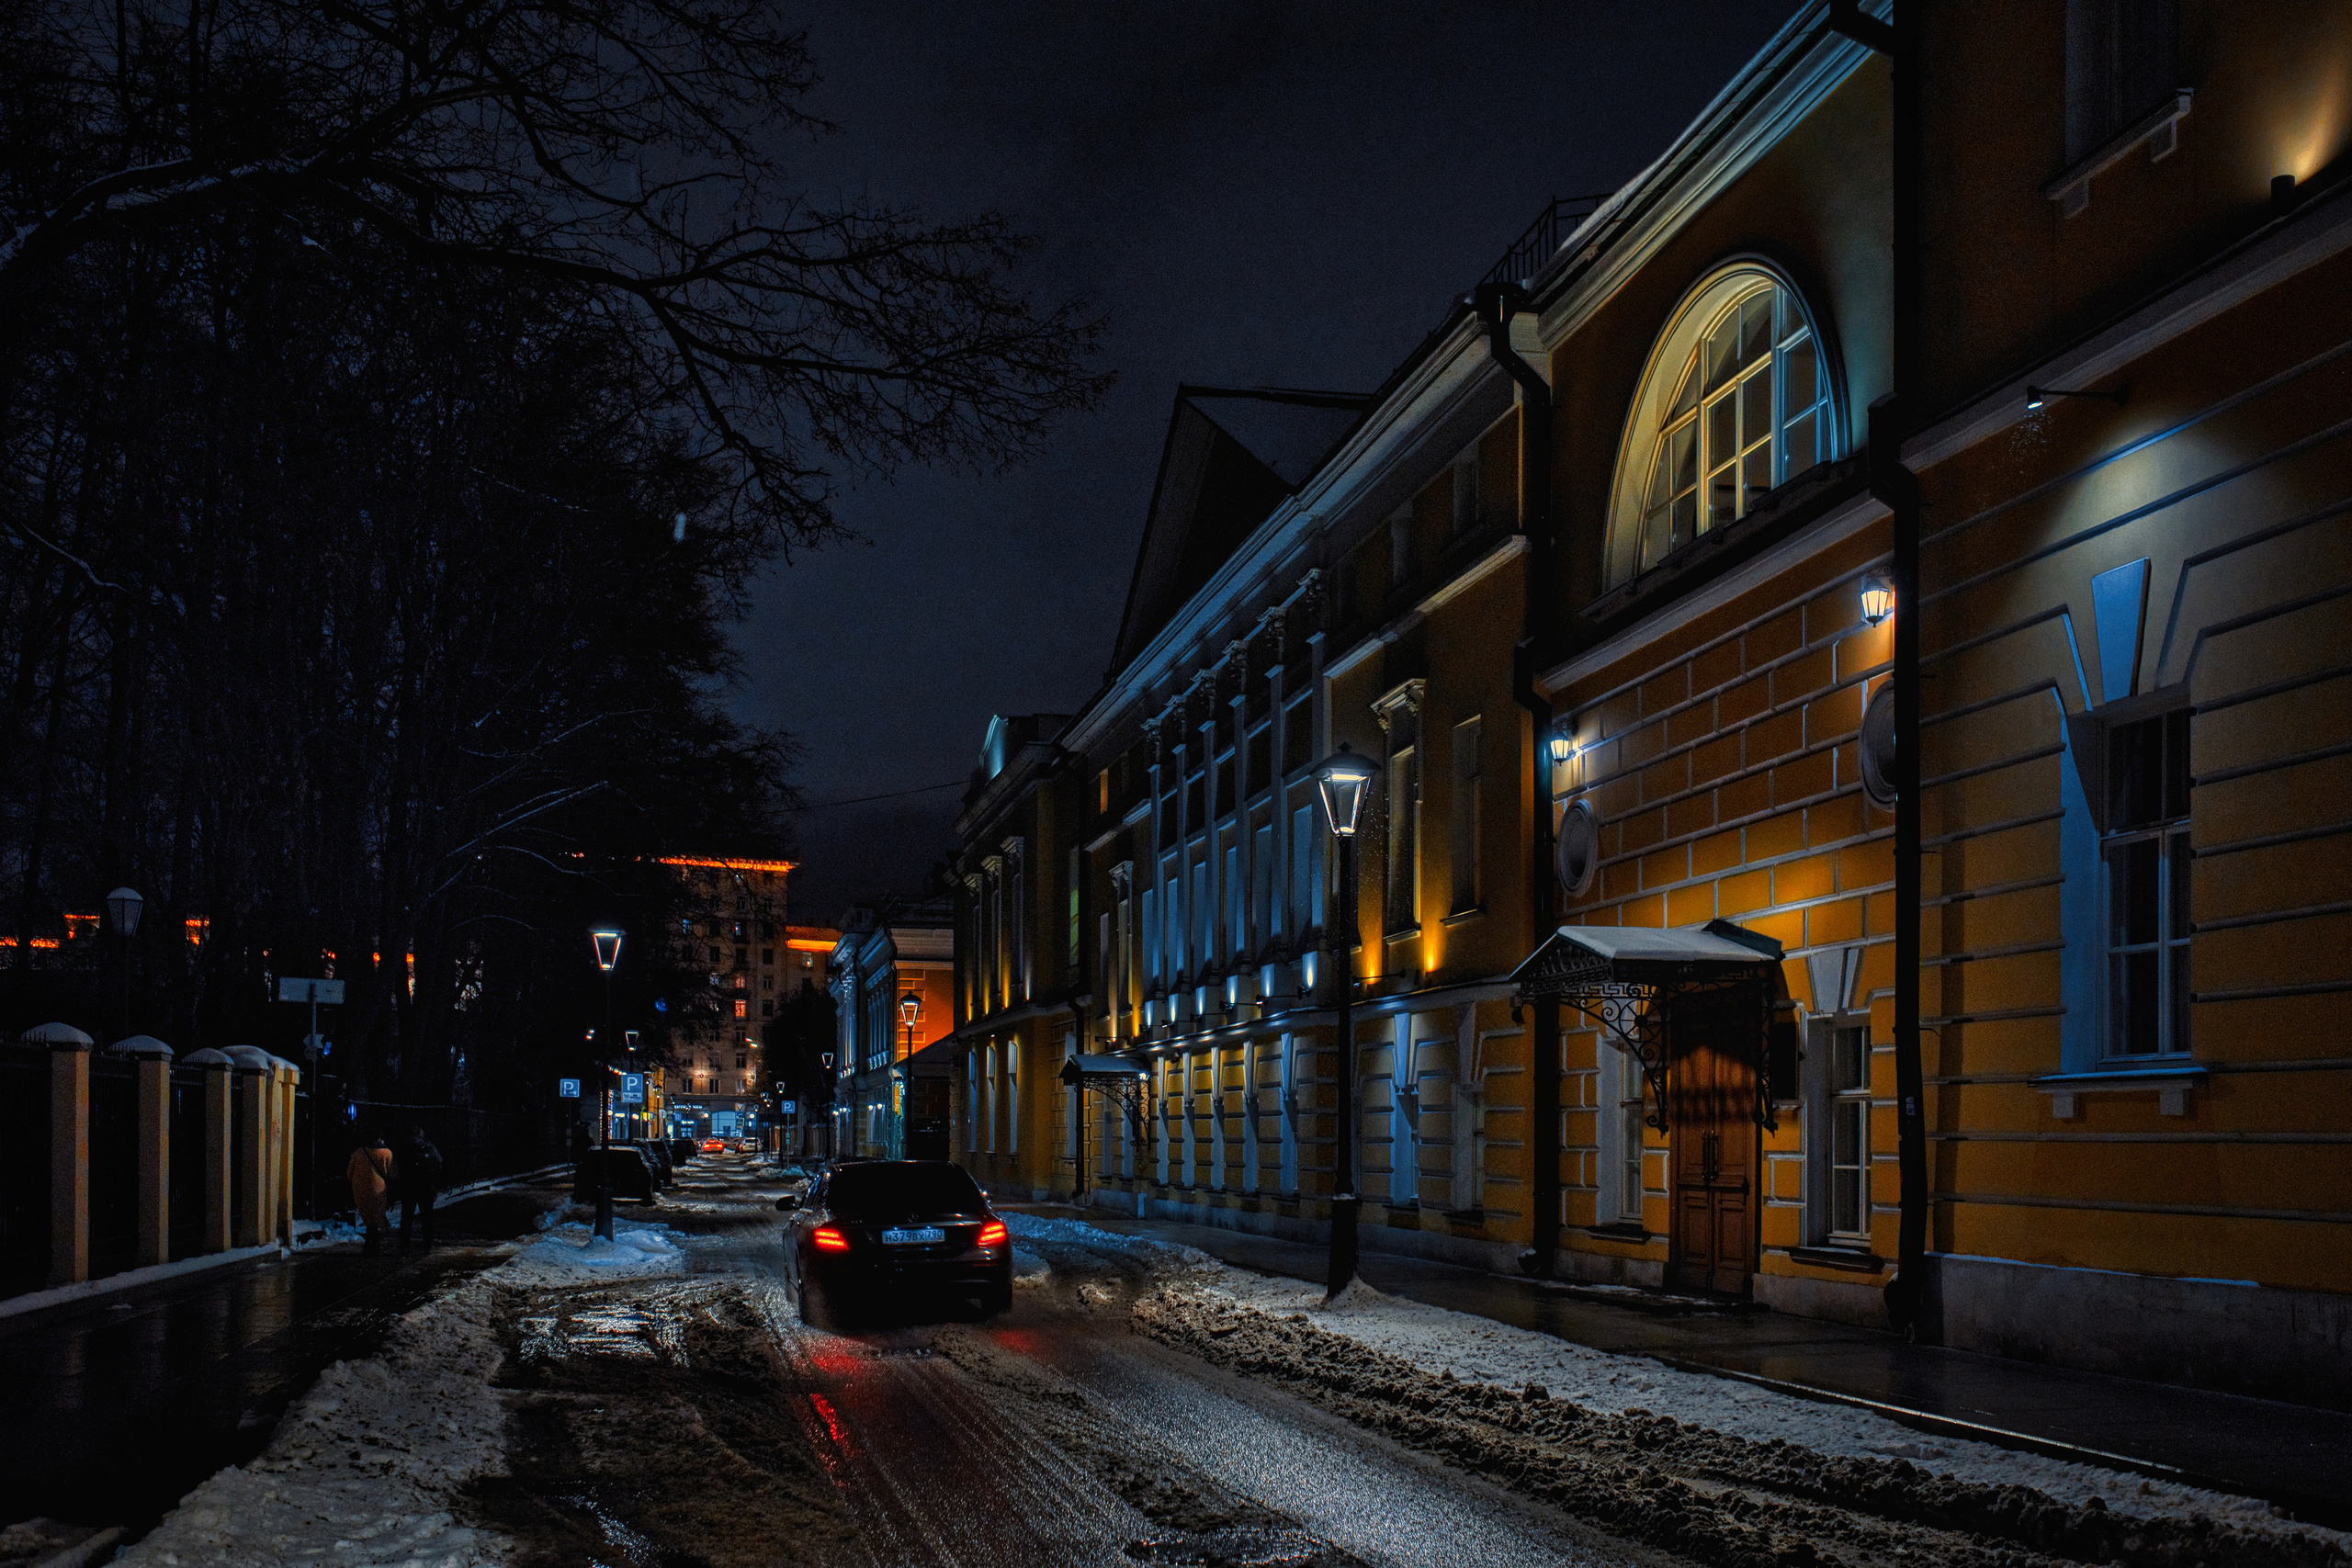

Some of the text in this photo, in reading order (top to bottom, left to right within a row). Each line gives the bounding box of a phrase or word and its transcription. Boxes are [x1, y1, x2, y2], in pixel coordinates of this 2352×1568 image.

[563, 1081, 574, 1094] P
[627, 1077, 638, 1090] P
[784, 1102, 792, 1111] P
